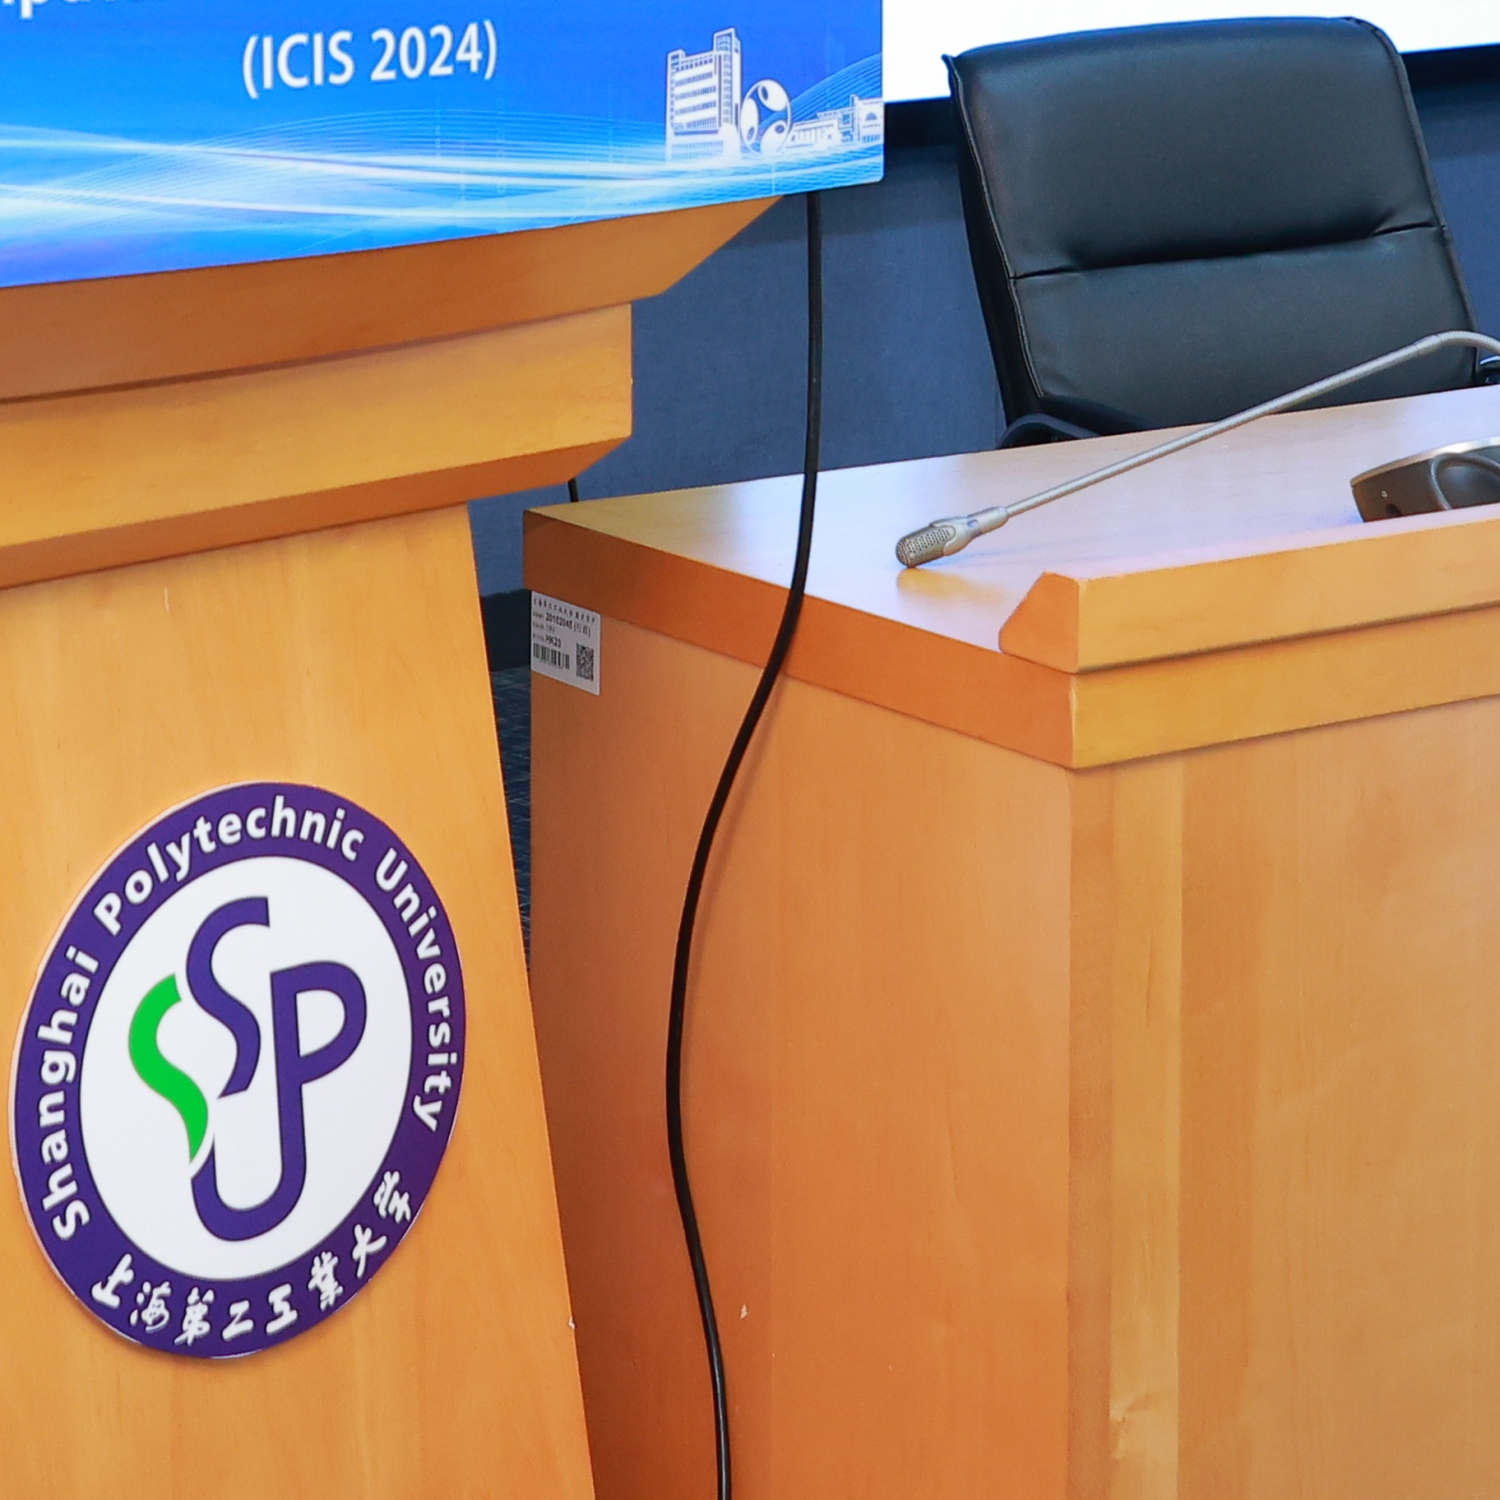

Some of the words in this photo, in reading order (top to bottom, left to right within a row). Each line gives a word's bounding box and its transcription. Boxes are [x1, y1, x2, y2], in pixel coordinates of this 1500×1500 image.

[242, 30, 355, 100] (ICIS
[370, 19, 498, 83] 2024)
[36, 945, 100, 1241] Shanghai
[93, 795, 365, 936] Polytechnic
[375, 846, 459, 1133] University
